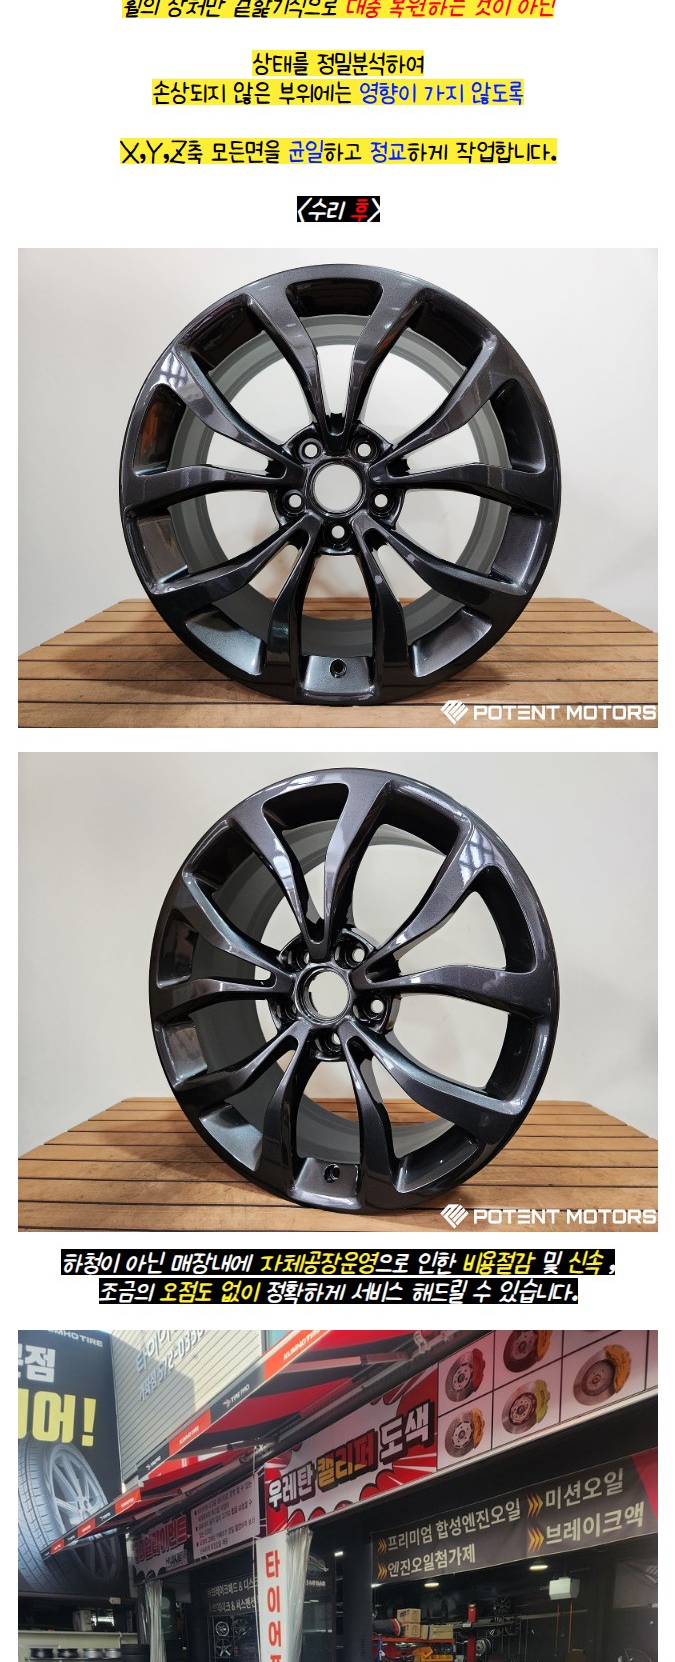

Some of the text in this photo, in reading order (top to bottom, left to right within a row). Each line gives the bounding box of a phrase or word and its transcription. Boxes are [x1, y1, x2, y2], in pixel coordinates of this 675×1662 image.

[18, 1343, 56, 1383] 점
[268, 1463, 313, 1508] 우레탄
[380, 1402, 430, 1460] 도색
[545, 1467, 624, 1510] 미션오일
[387, 1497, 521, 1552] 프리미엄 합성엔진오일
[545, 1501, 644, 1545] 브레이크액
[387, 1543, 476, 1578] 엔진오일첨가제
